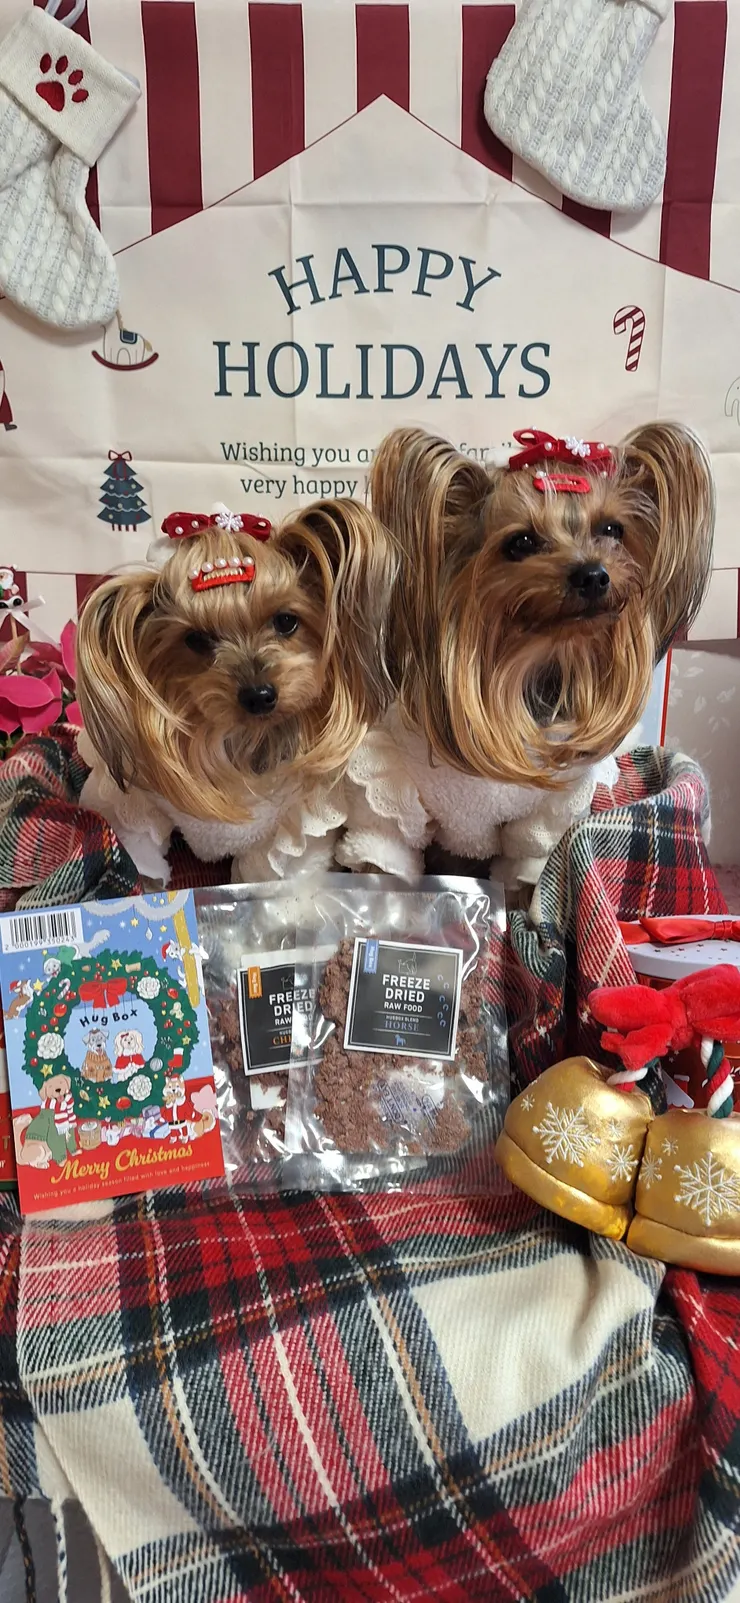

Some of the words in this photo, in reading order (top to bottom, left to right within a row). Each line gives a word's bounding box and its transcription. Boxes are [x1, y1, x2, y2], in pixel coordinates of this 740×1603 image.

[267, 244, 502, 316] HAPPY
[212, 340, 551, 400] HOLIDAYS
[220, 442, 306, 467] Wishing
[312, 447, 351, 467] you
[240, 478, 287, 499] very
[292, 475, 358, 500] happy
[382, 974, 431, 990] FREEZE
[269, 988, 317, 1006] FREEZE
[385, 987, 425, 1003] DRIED
[384, 1002, 401, 1010] RAW
[403, 1004, 423, 1013] FOOD
[79, 1015, 108, 1026] Hug
[112, 1009, 138, 1022] Box
[275, 1016, 292, 1026] RAW
[384, 1020, 419, 1031] HORSE
[50, 1159, 110, 1184] Merry
[115, 1144, 193, 1172] Christmas
[33, 1191, 59, 1200] Wishing
[59, 1188, 72, 1197] you
[78, 1182, 100, 1192] holiday
[101, 1178, 123, 1188] season
[123, 1174, 139, 1182] filled
[140, 1171, 154, 1179] with
[154, 1169, 168, 1177] love
[168, 1165, 180, 1174] and
